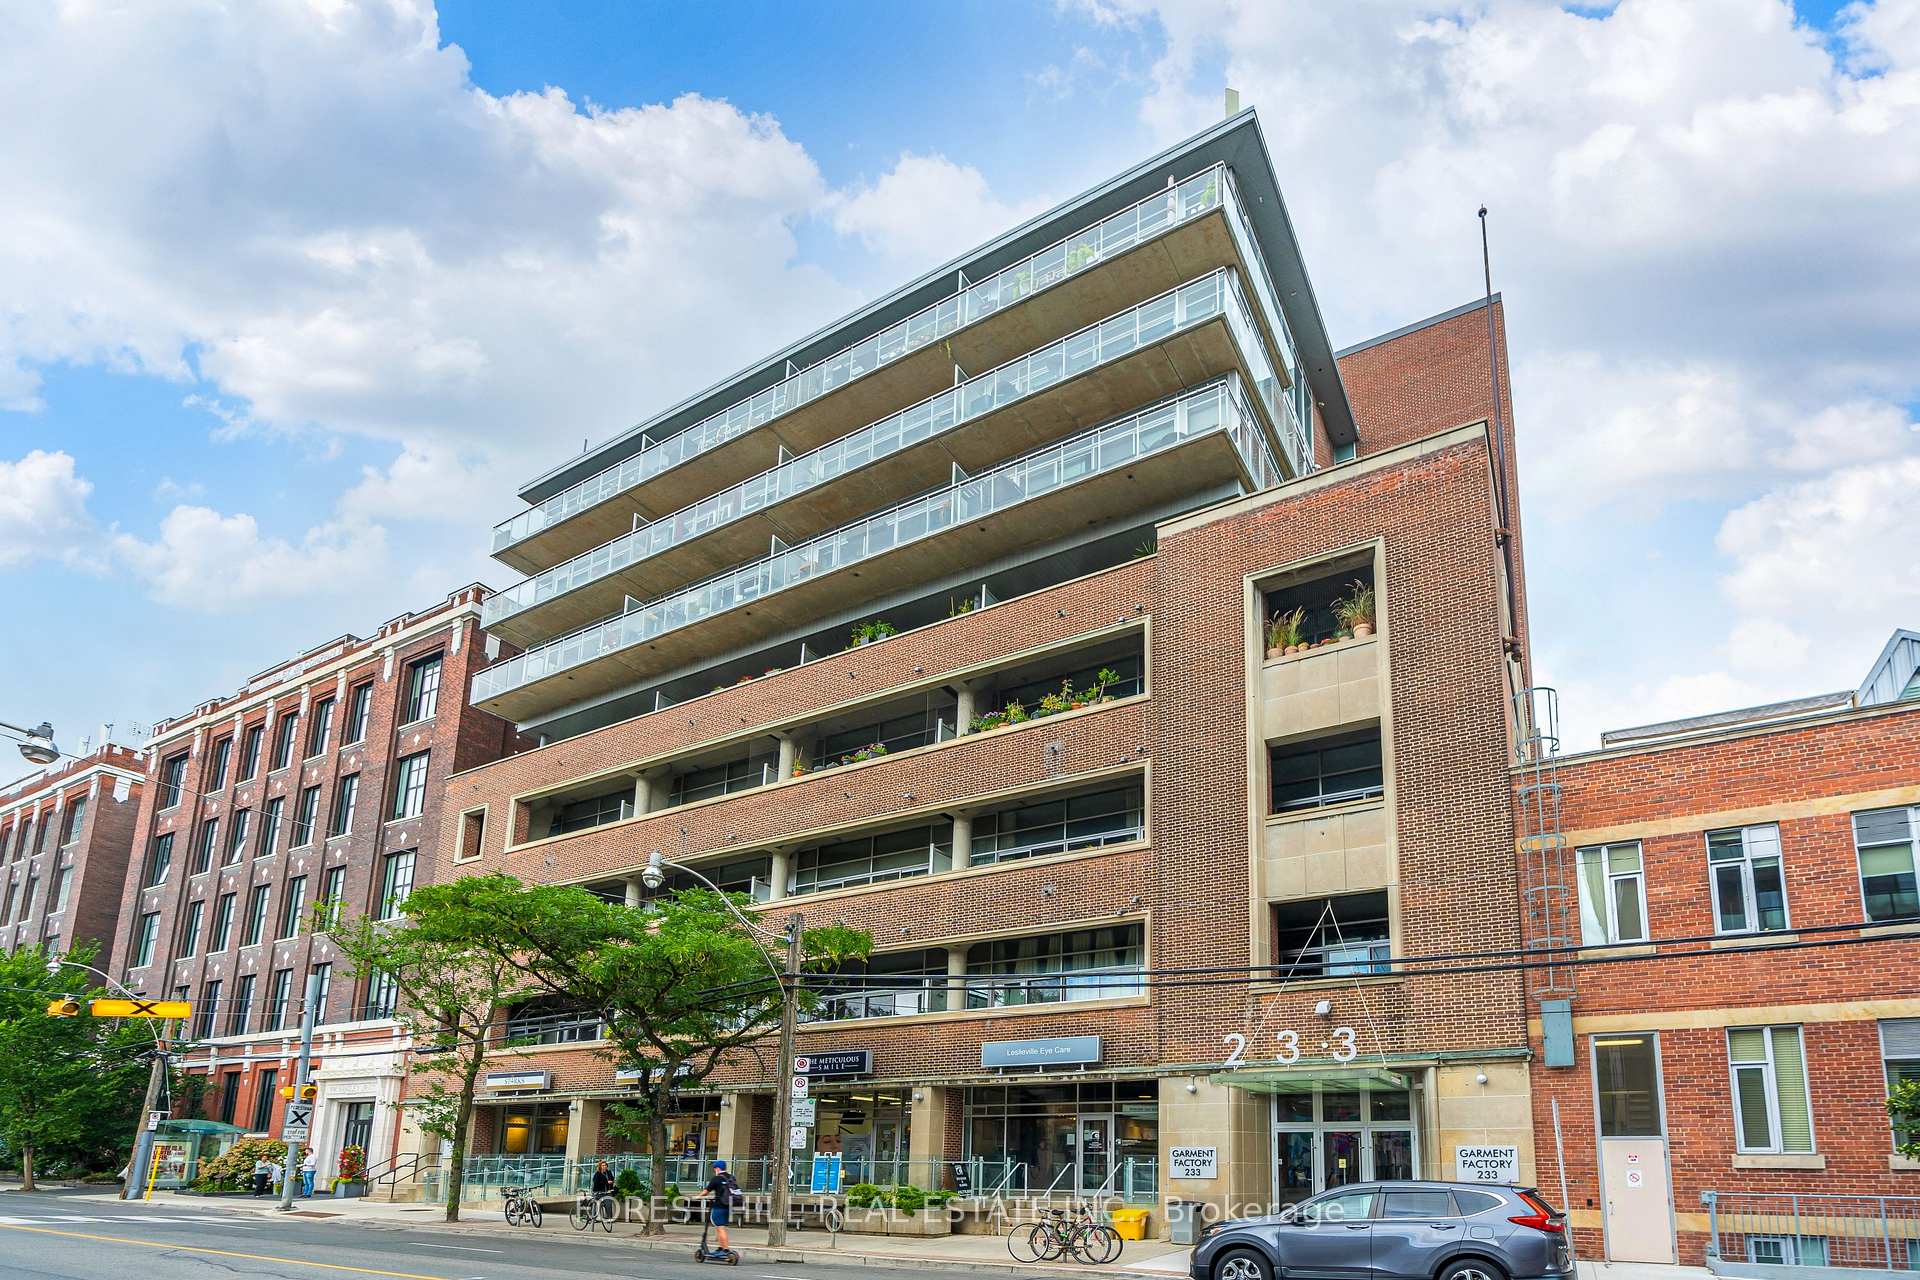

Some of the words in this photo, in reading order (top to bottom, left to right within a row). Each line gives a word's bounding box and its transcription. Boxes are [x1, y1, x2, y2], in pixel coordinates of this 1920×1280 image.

[1040, 1047, 1053, 1056] Eye
[1054, 1046, 1071, 1054] Care
[819, 1055, 860, 1064] METICULOUS
[818, 1063, 846, 1071] SMILE
[1172, 1149, 1214, 1158] GARMENT
[1459, 1149, 1514, 1158] GARMENT
[1174, 1159, 1213, 1167] FACTORY
[1462, 1160, 1513, 1168] FACTORY
[1184, 1168, 1201, 1176] 233
[1477, 1170, 1498, 1180] 233
